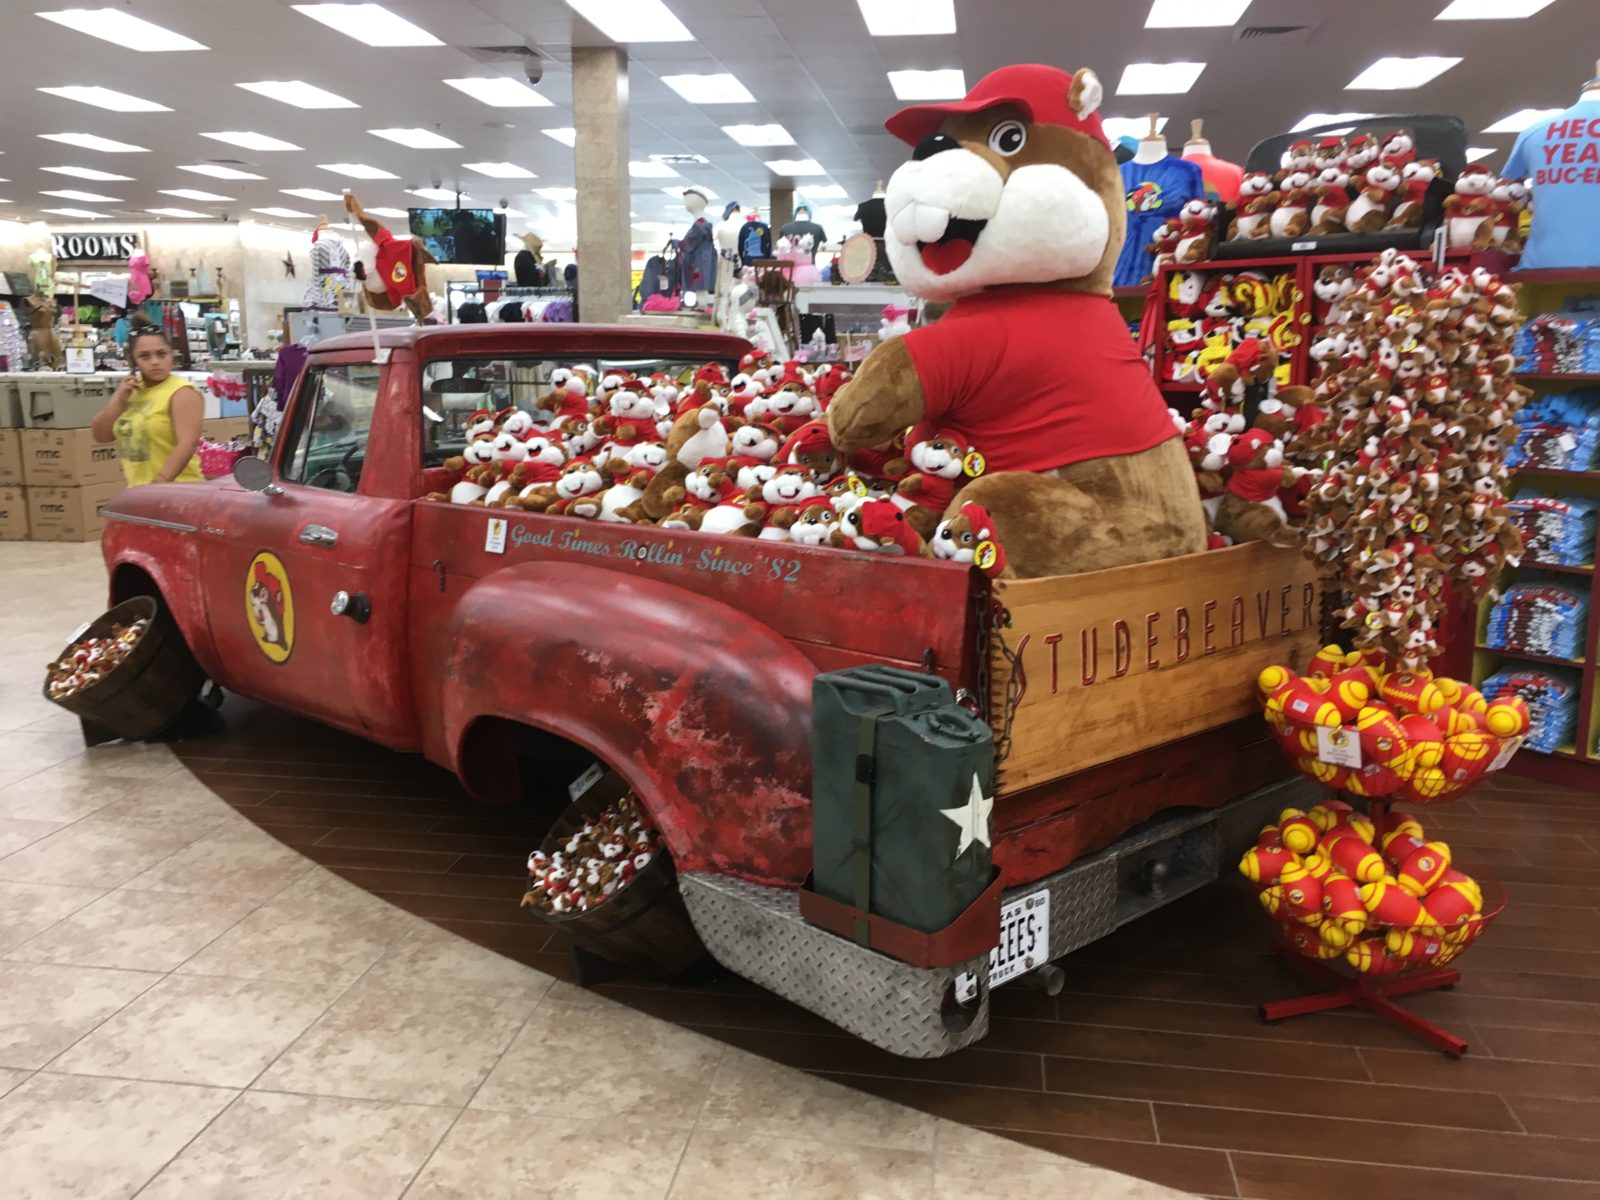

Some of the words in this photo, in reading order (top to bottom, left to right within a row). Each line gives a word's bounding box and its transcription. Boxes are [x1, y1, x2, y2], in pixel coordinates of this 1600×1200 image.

[1543, 143, 1599, 165] YEA
[51, 235, 134, 259] ROOMS
[511, 524, 554, 548] Good
[560, 527, 610, 556] Times
[696, 546, 753, 576] Since
[763, 556, 801, 583] '82
[1014, 582, 1315, 708] STUDEBEAVER
